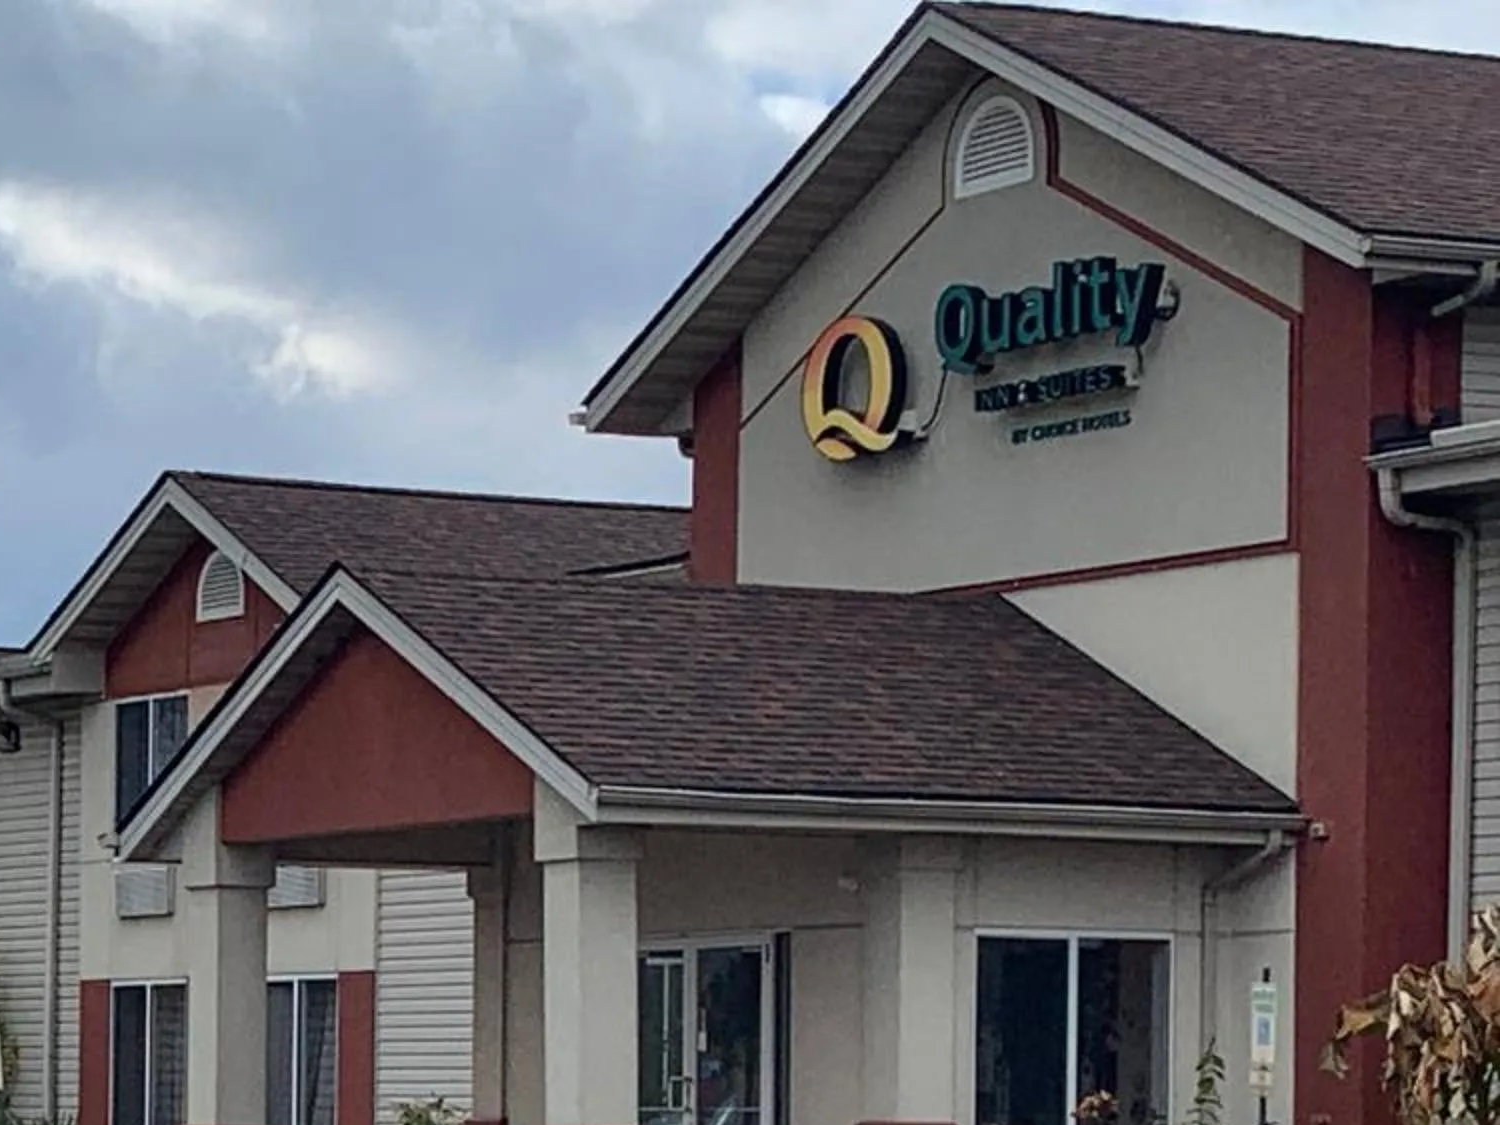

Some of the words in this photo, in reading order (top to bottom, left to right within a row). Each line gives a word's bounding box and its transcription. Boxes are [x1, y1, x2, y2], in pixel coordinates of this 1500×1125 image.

[935, 257, 1165, 373] Quality
[803, 316, 905, 461] Q
[975, 384, 1015, 412] INN
[1035, 365, 1124, 402] SUITES
